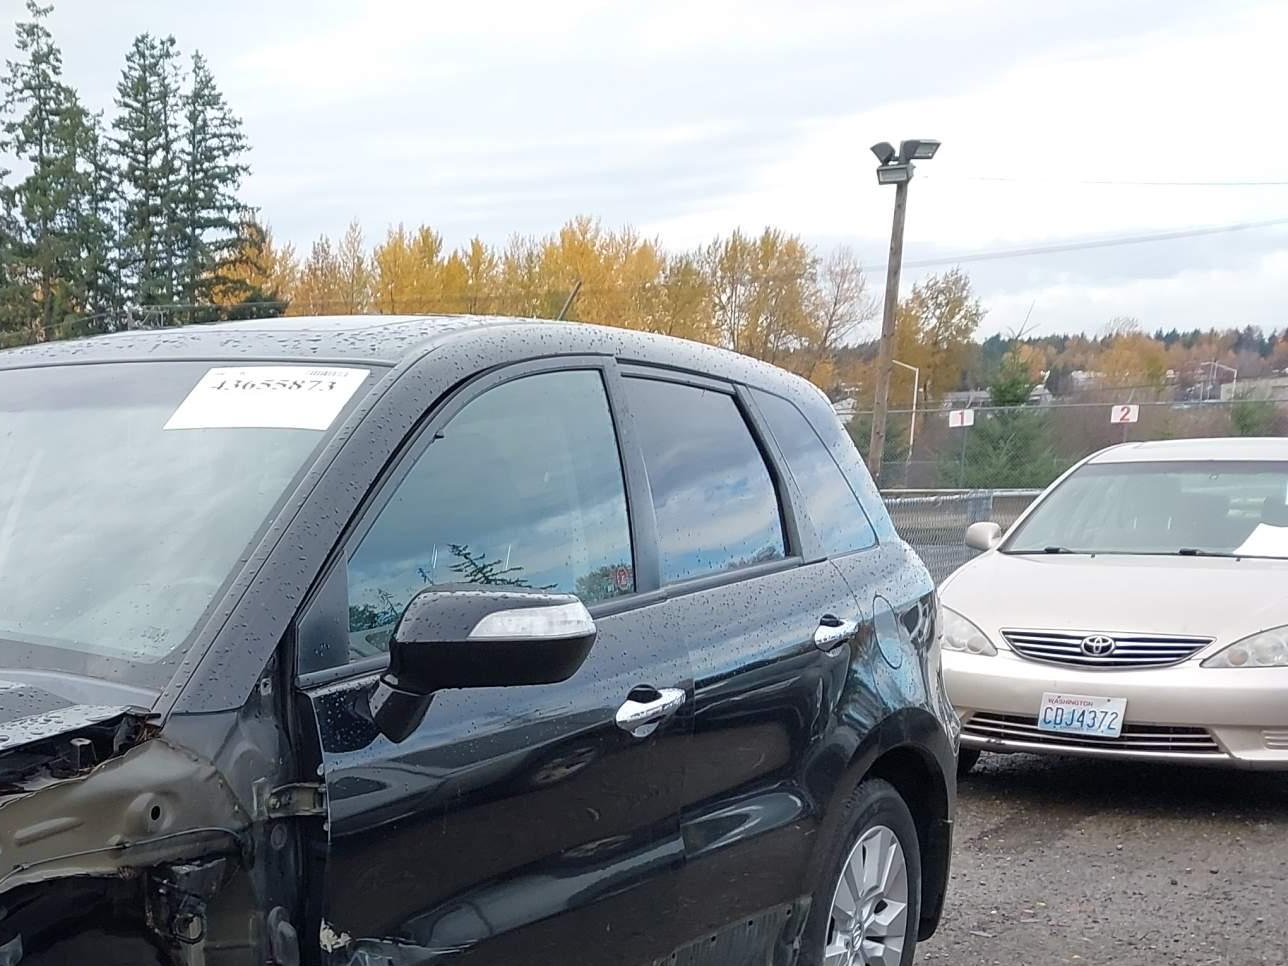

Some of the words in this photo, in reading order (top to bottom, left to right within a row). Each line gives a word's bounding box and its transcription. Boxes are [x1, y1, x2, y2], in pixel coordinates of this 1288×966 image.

[956, 411, 964, 424] 1
[1120, 407, 1131, 421] 2
[1048, 698, 1094, 707] WASHINGTON
[1043, 706, 1119, 731] CDJ4372
